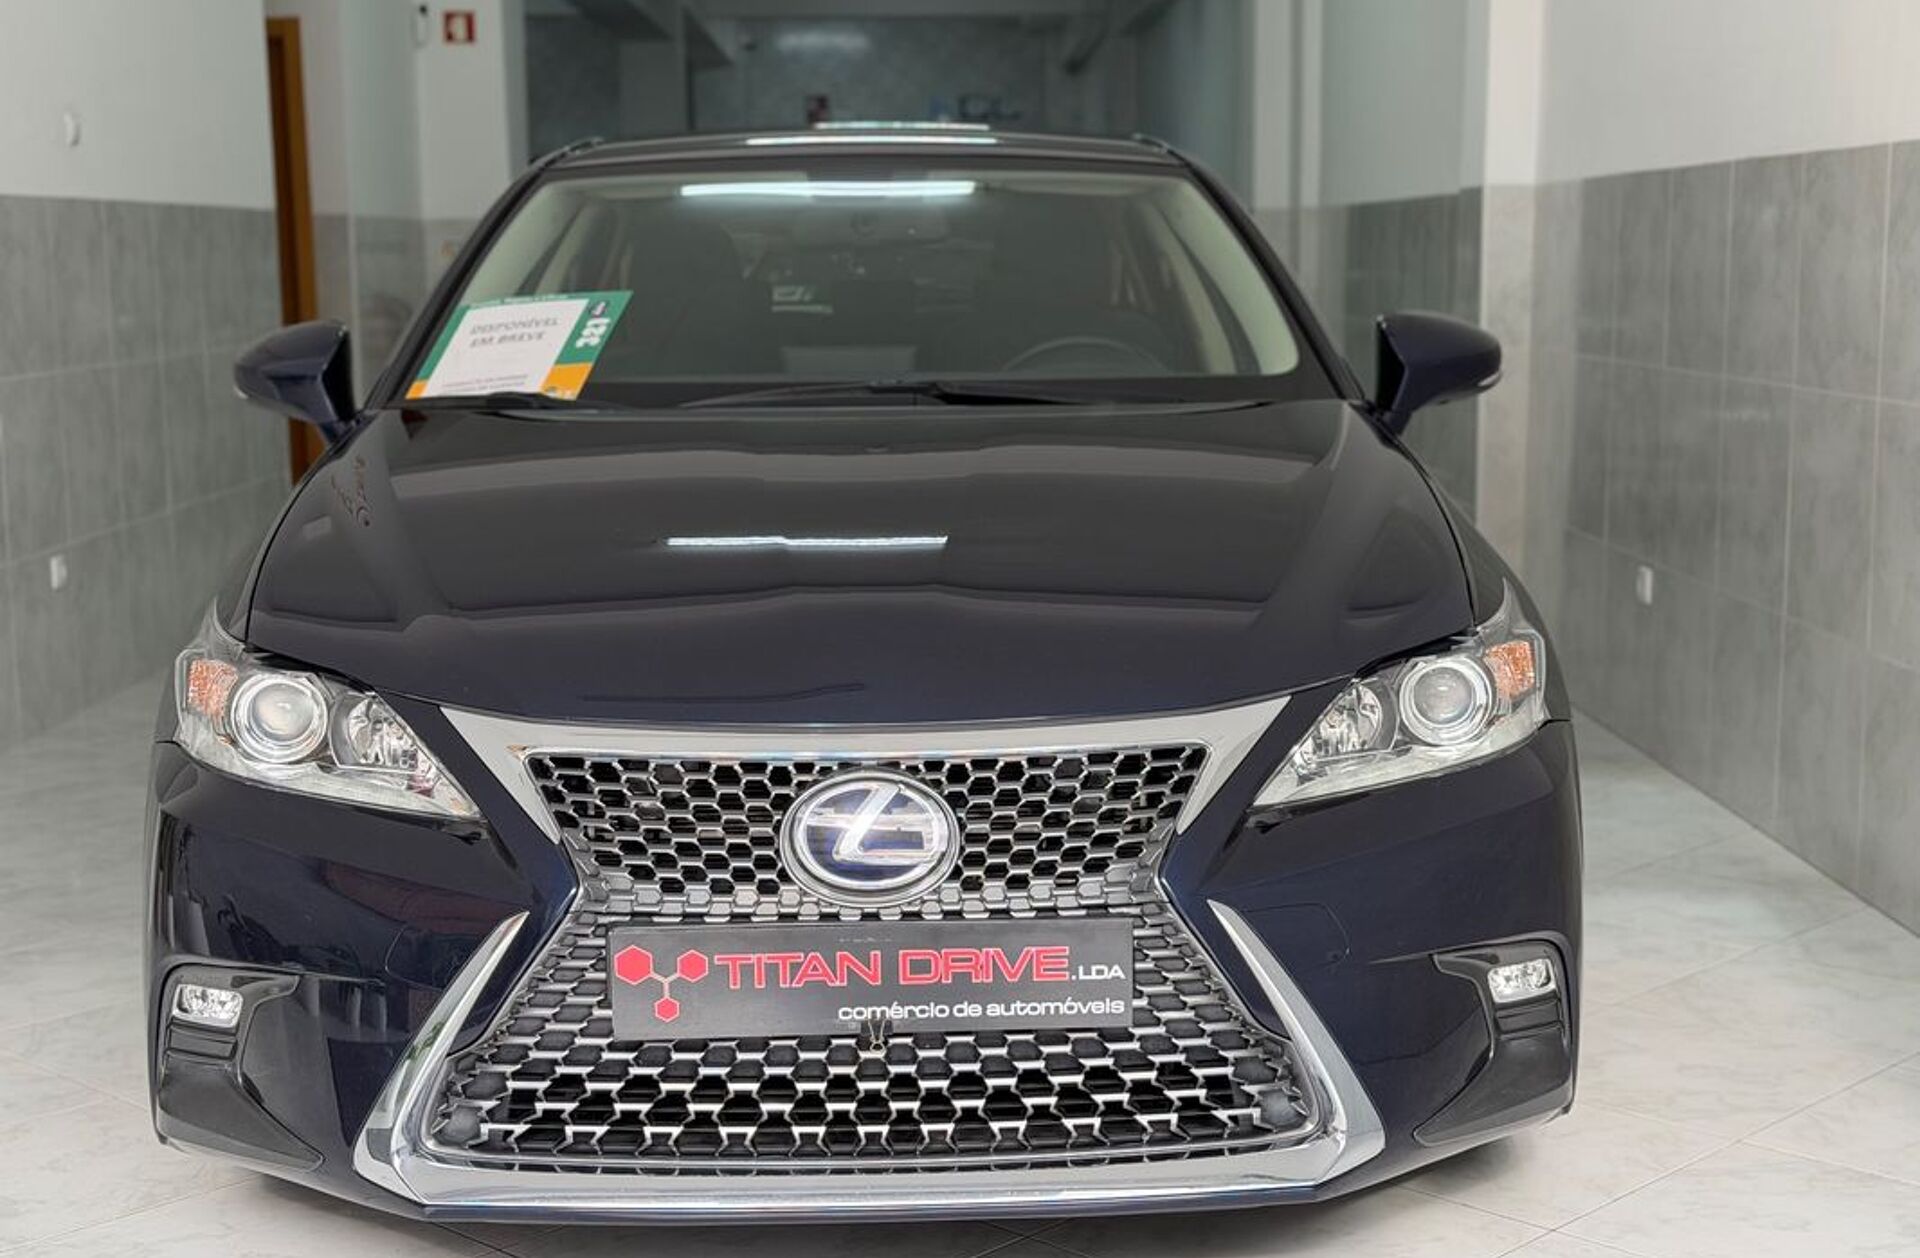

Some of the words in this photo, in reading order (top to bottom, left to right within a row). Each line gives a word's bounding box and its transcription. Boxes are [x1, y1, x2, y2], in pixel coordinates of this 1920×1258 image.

[470, 335, 495, 348] EM
[497, 330, 546, 344] BREVE
[714, 950, 882, 989] TITAN
[898, 946, 1070, 985] DRIVE
[838, 1001, 950, 1020] comércio
[952, 1001, 982, 1018] de
[986, 997, 1125, 1016] automóveis
